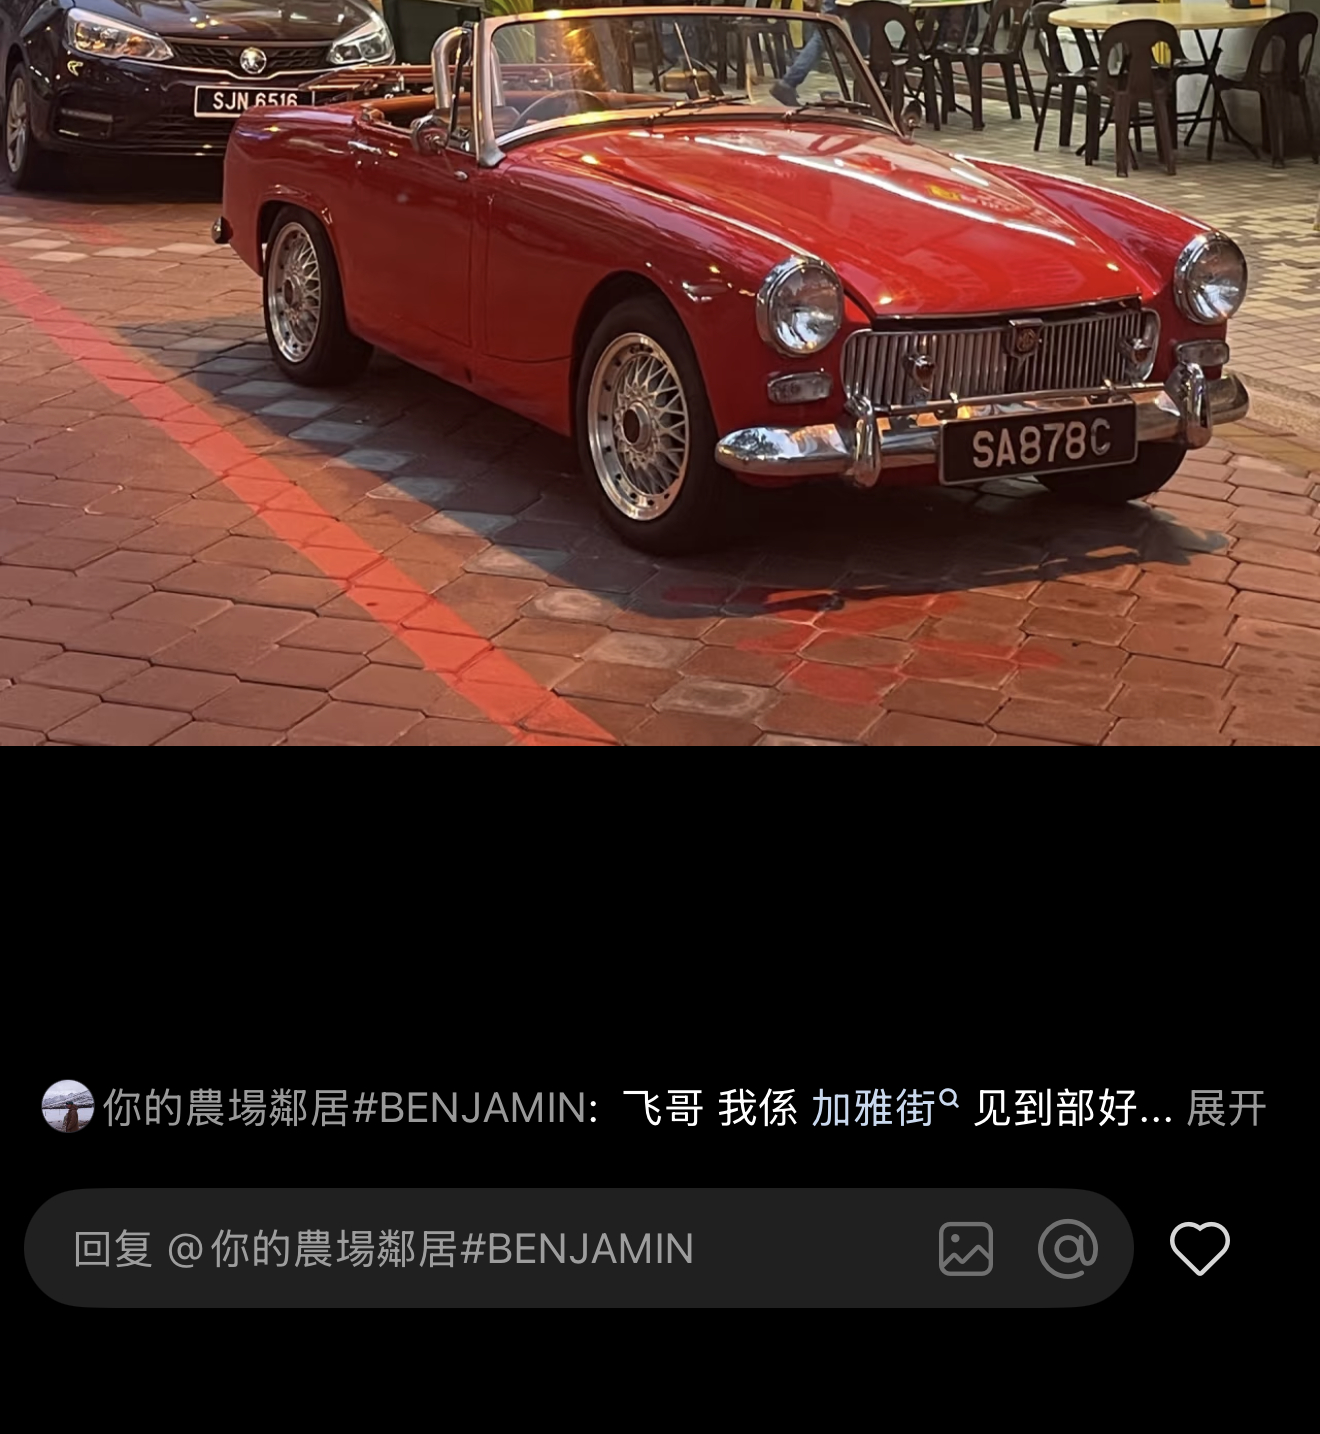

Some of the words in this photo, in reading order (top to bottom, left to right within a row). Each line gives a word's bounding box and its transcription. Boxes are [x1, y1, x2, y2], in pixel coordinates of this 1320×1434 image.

[213, 92, 248, 110] SJN
[255, 93, 298, 106] 6516
[972, 418, 1111, 469] SA878C
